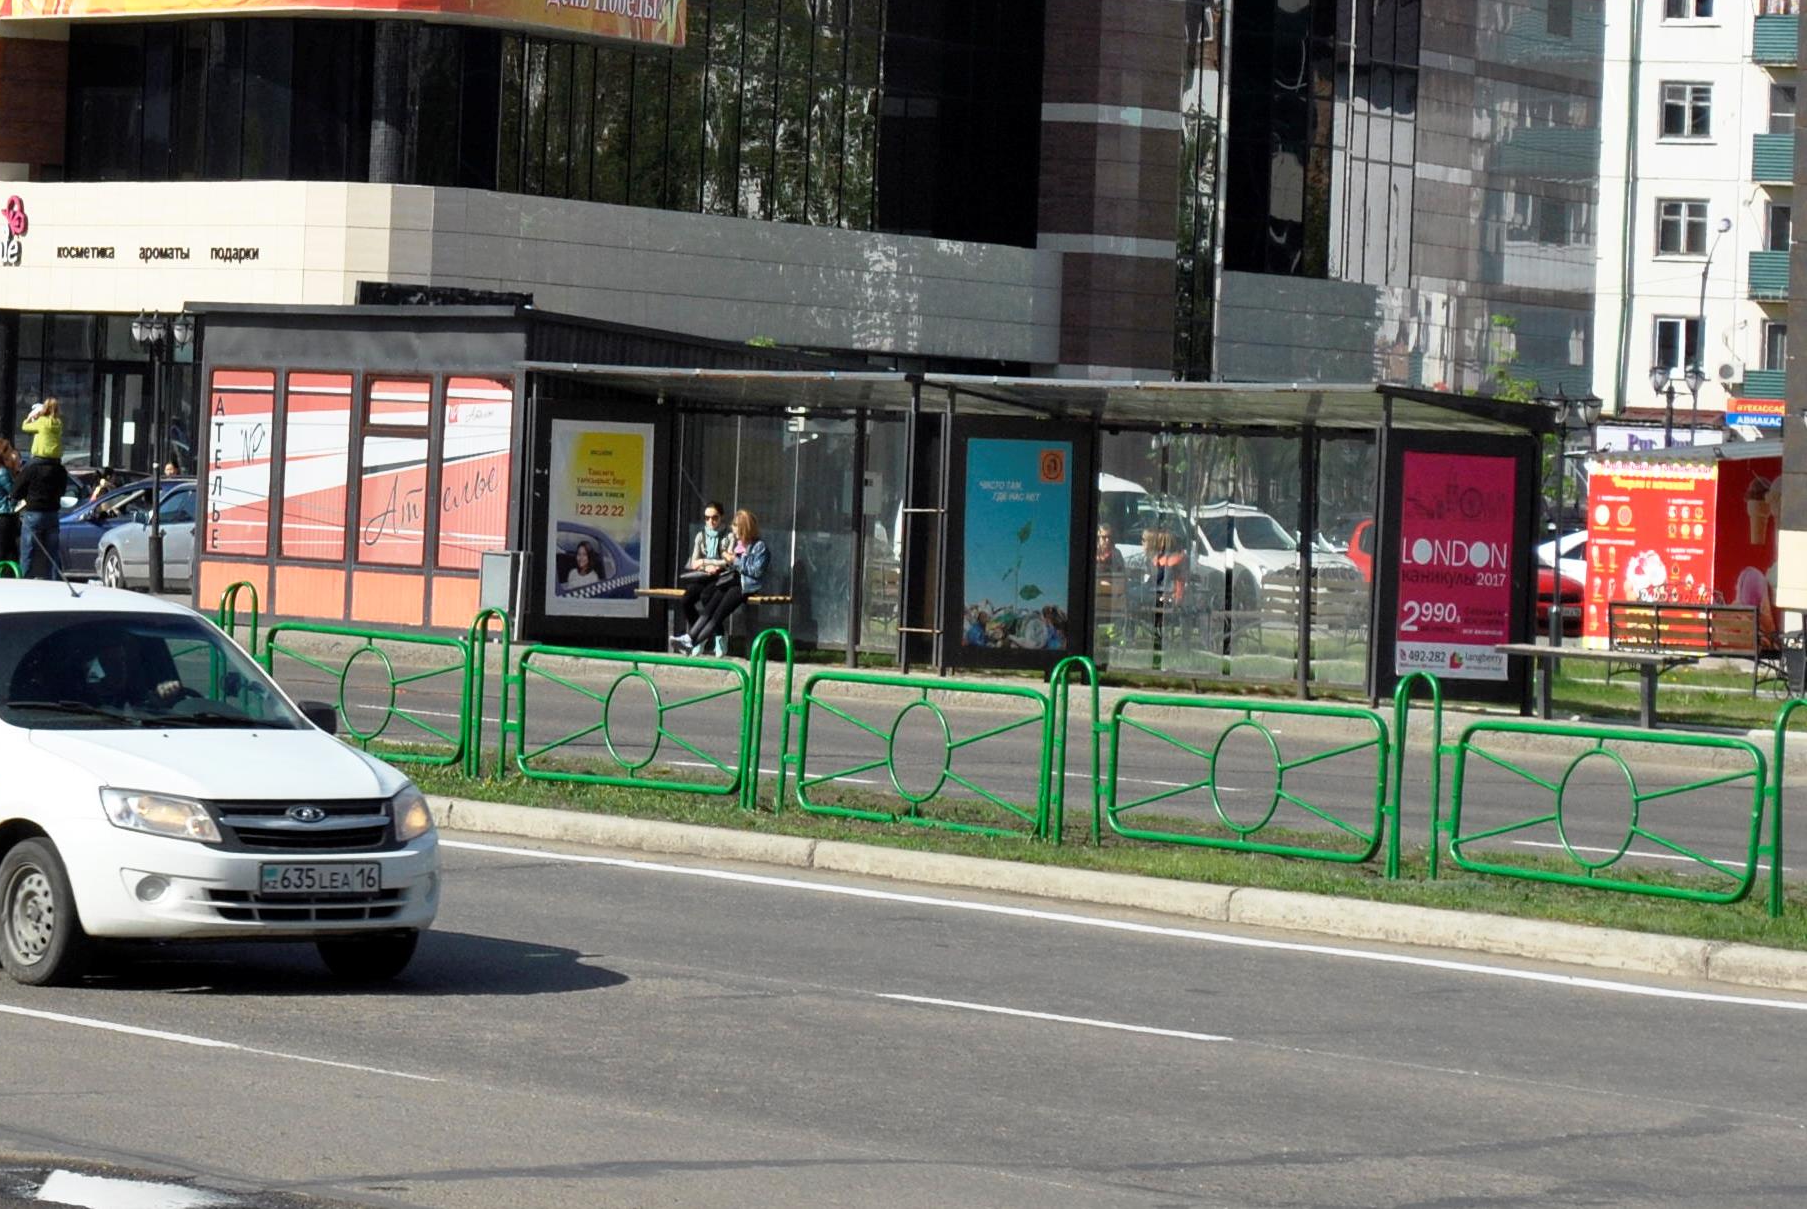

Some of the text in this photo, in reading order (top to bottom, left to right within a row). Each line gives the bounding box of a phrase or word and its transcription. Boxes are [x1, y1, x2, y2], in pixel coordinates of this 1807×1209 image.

[56, 245, 260, 265] косметика ароматы подарки
[210, 395, 226, 550] АТЕЛЬЕ
[1402, 537, 1508, 569] LONDON
[1477, 572, 1506, 587] 2017
[280, 867, 316, 889] 635
[319, 872, 351, 890] LEA
[356, 867, 377, 889] 16
